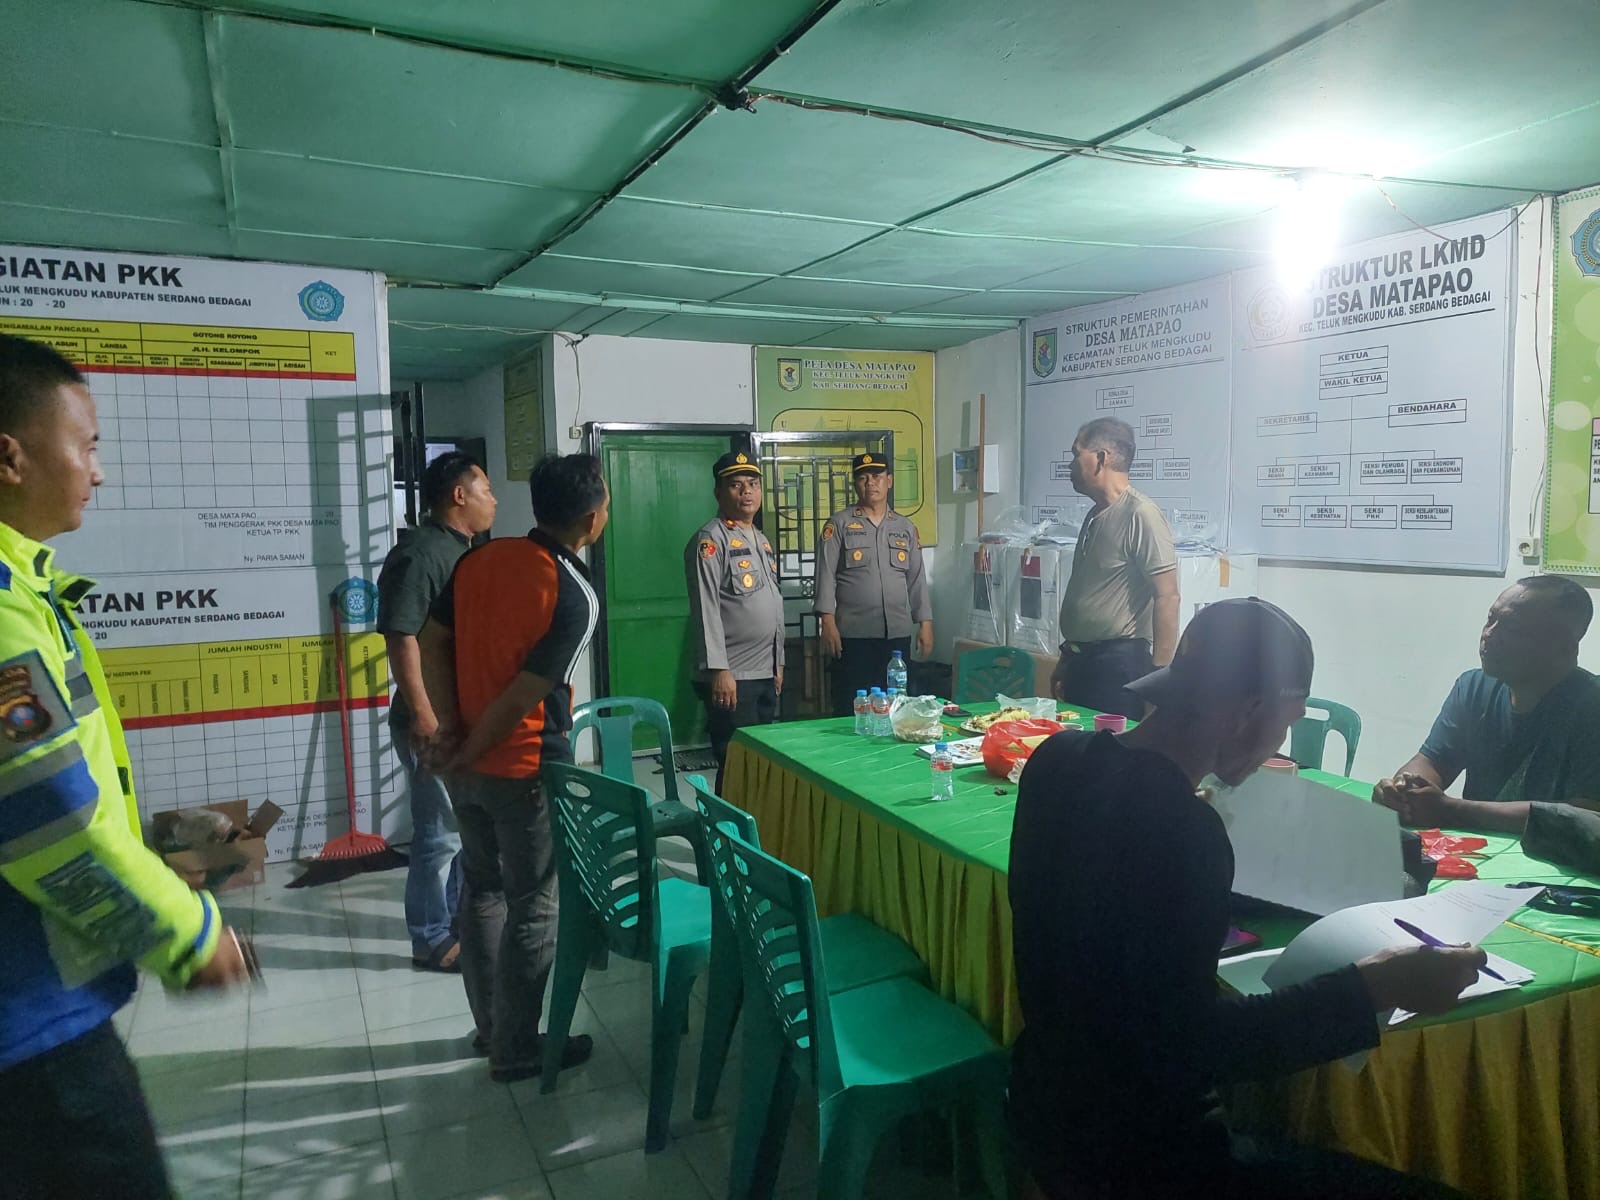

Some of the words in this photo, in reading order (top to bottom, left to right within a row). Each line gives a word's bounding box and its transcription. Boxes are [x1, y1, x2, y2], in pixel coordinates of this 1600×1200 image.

[1312, 250, 1413, 291] TRUKTUR
[1420, 233, 1486, 270] LKMD
[117, 263, 184, 288] PKK
[24, 286, 88, 298] MENGKUDU
[91, 290, 154, 302] KABUPATEN
[157, 293, 205, 304] SERDANG
[208, 296, 252, 307] BEDAGAI
[1313, 287, 1364, 319] DESA
[1370, 267, 1473, 309] MATAPAO
[20, 298, 33, 307] 20
[1317, 318, 1340, 331] TELUK
[1342, 308, 1386, 327] MENGKUDU
[1409, 298, 1449, 315] SERDANG
[1451, 290, 1491, 308] BEDAGAI
[1066, 316, 1118, 336] STRUKTUR
[1120, 297, 1209, 325] PEMERINTAHAN
[1085, 330, 1116, 348] DESA
[1120, 318, 1182, 342] MATAPAO
[1063, 347, 1115, 363] KECAMATAN
[1118, 342, 1148, 355] TELUK
[1151, 331, 1211, 350] MENGKUDU
[1061, 359, 1113, 374] KABUPATEN
[1115, 351, 1161, 367] SERDANG
[1164, 344, 1213, 361] BEDAGAI
[1338, 351, 1369, 362] KETUA
[804, 360, 832, 370] PETA
[834, 361, 863, 371] DESA
[865, 362, 916, 373] MATAPAO
[1324, 377, 1351, 388] WAKIL
[1353, 374, 1383, 385] KETUA
[1397, 402, 1457, 415] BENDAHARA
[197, 513, 219, 521] DESA
[220, 512, 240, 520] MATA
[241, 512, 257, 520] PAO
[204, 521, 217, 529] TIM
[218, 520, 266, 529] PENGGERAK
[267, 520, 283, 528] PKK
[283, 519, 304, 528] DESA
[246, 528, 272, 537] KETUA
[284, 528, 301, 536] PKK
[256, 553, 279, 562] PARIA
[279, 552, 306, 561] SAMAN
[156, 588, 219, 611] PKK
[130, 616, 192, 627] KABUPATEN
[194, 613, 241, 624] SERDANG
[243, 610, 285, 622] BEDAGAI
[207, 645, 242, 655] JUMLAH
[243, 643, 283, 652] INDUSTRI
